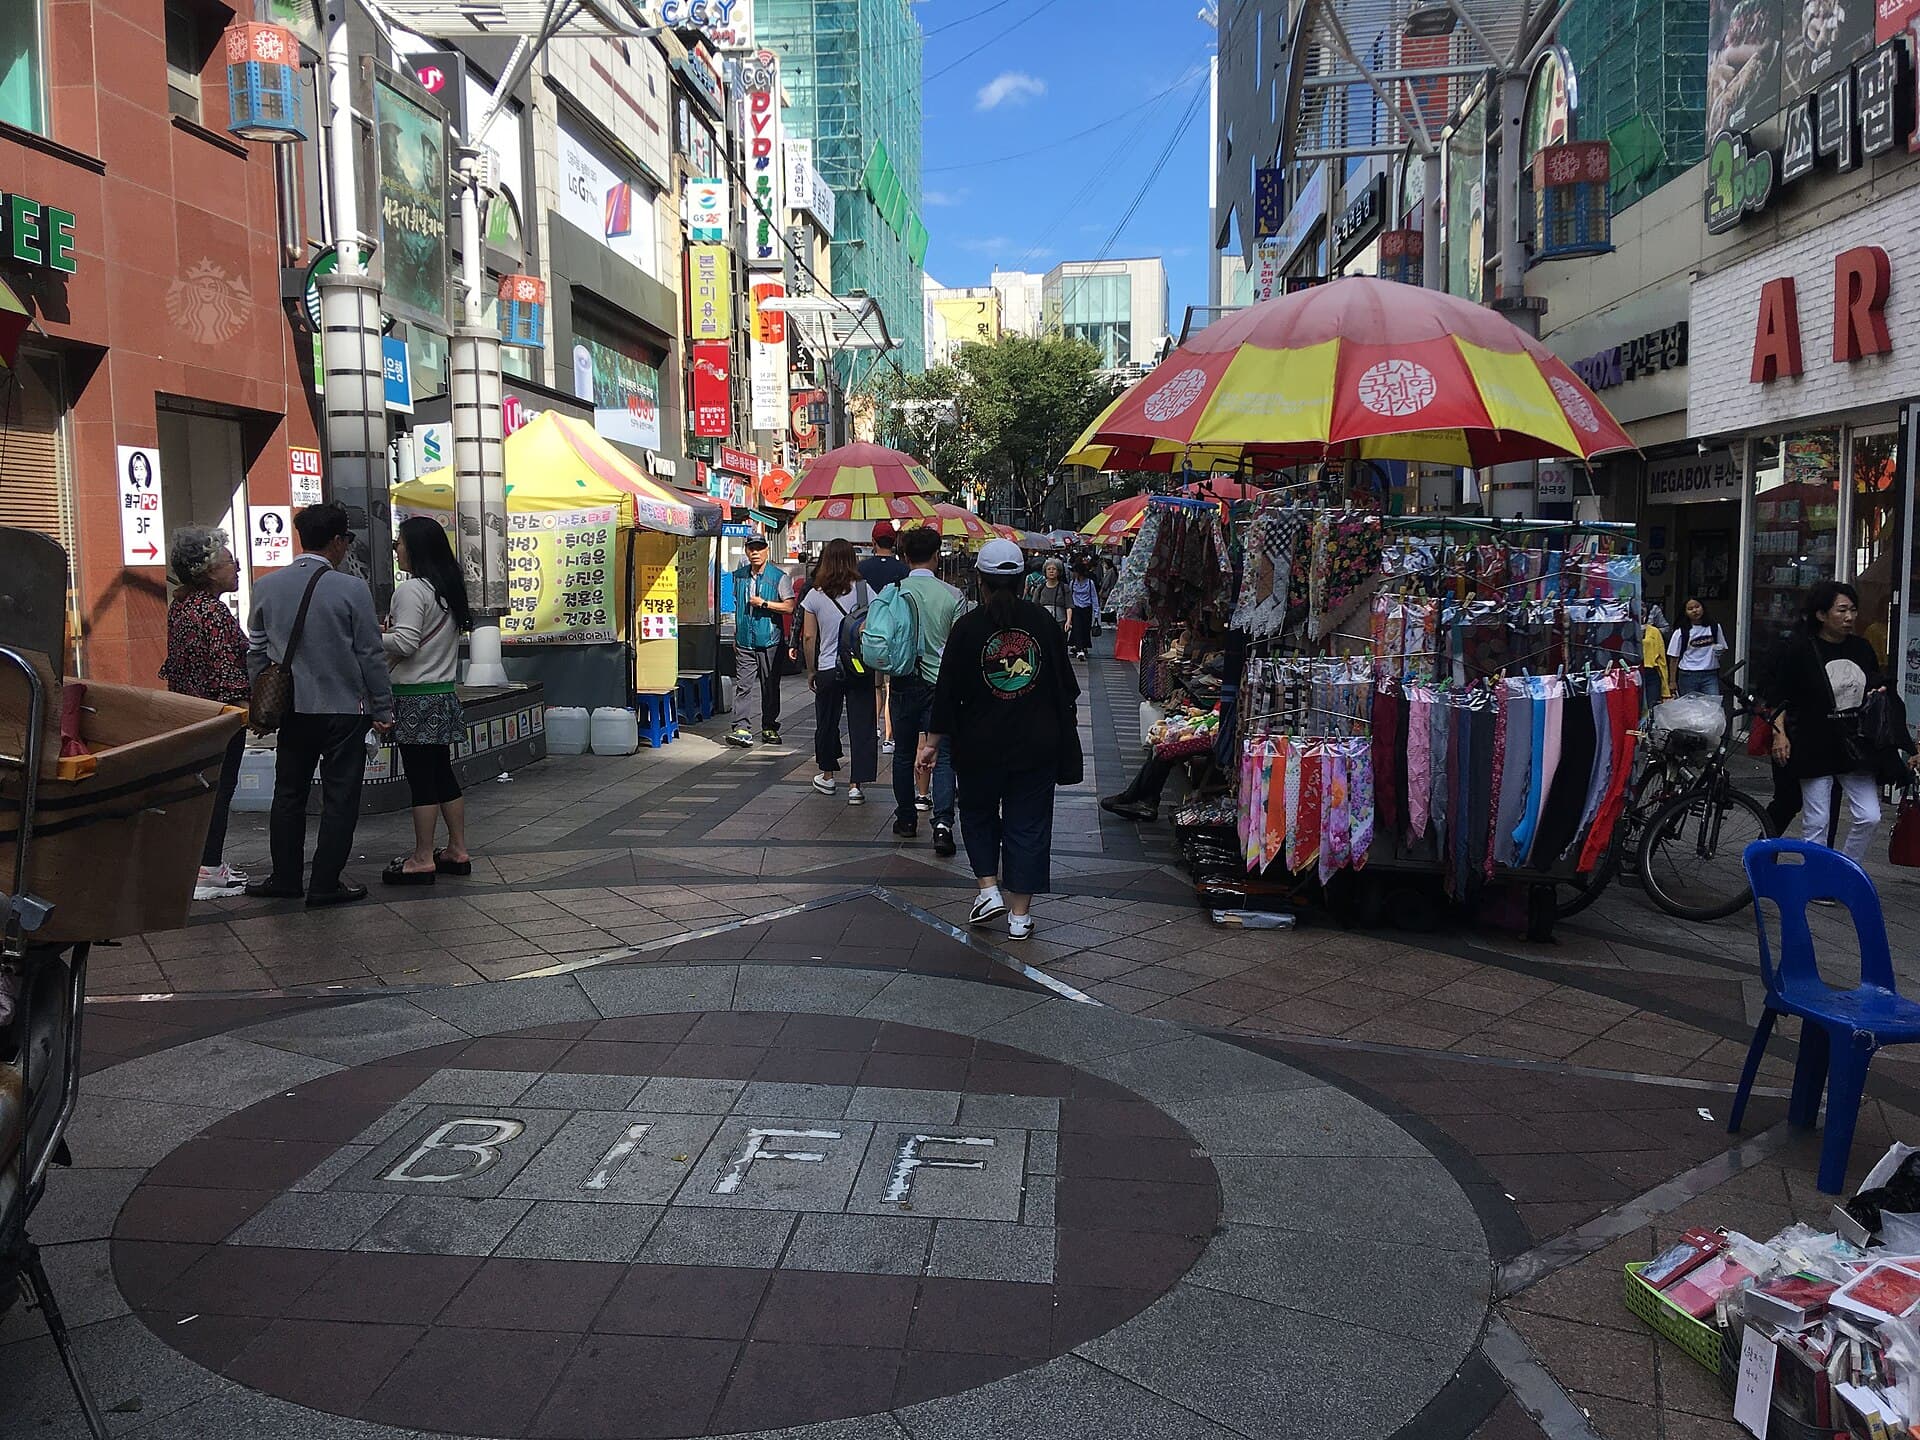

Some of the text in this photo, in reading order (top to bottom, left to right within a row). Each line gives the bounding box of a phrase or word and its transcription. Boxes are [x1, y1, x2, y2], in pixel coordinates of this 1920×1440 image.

[741, 67, 777, 87] CCY
[751, 92, 772, 157] DVD
[0, 190, 77, 275] EE
[291, 450, 319, 473] 임대
[1650, 464, 1712, 494] MEGABOX
[136, 517, 151, 534] 3F
[724, 526, 745, 535] ATM
[265, 550, 281, 561] 3F
[644, 599, 674, 613] 직장운
[374, 1115, 998, 1204] BIFF
